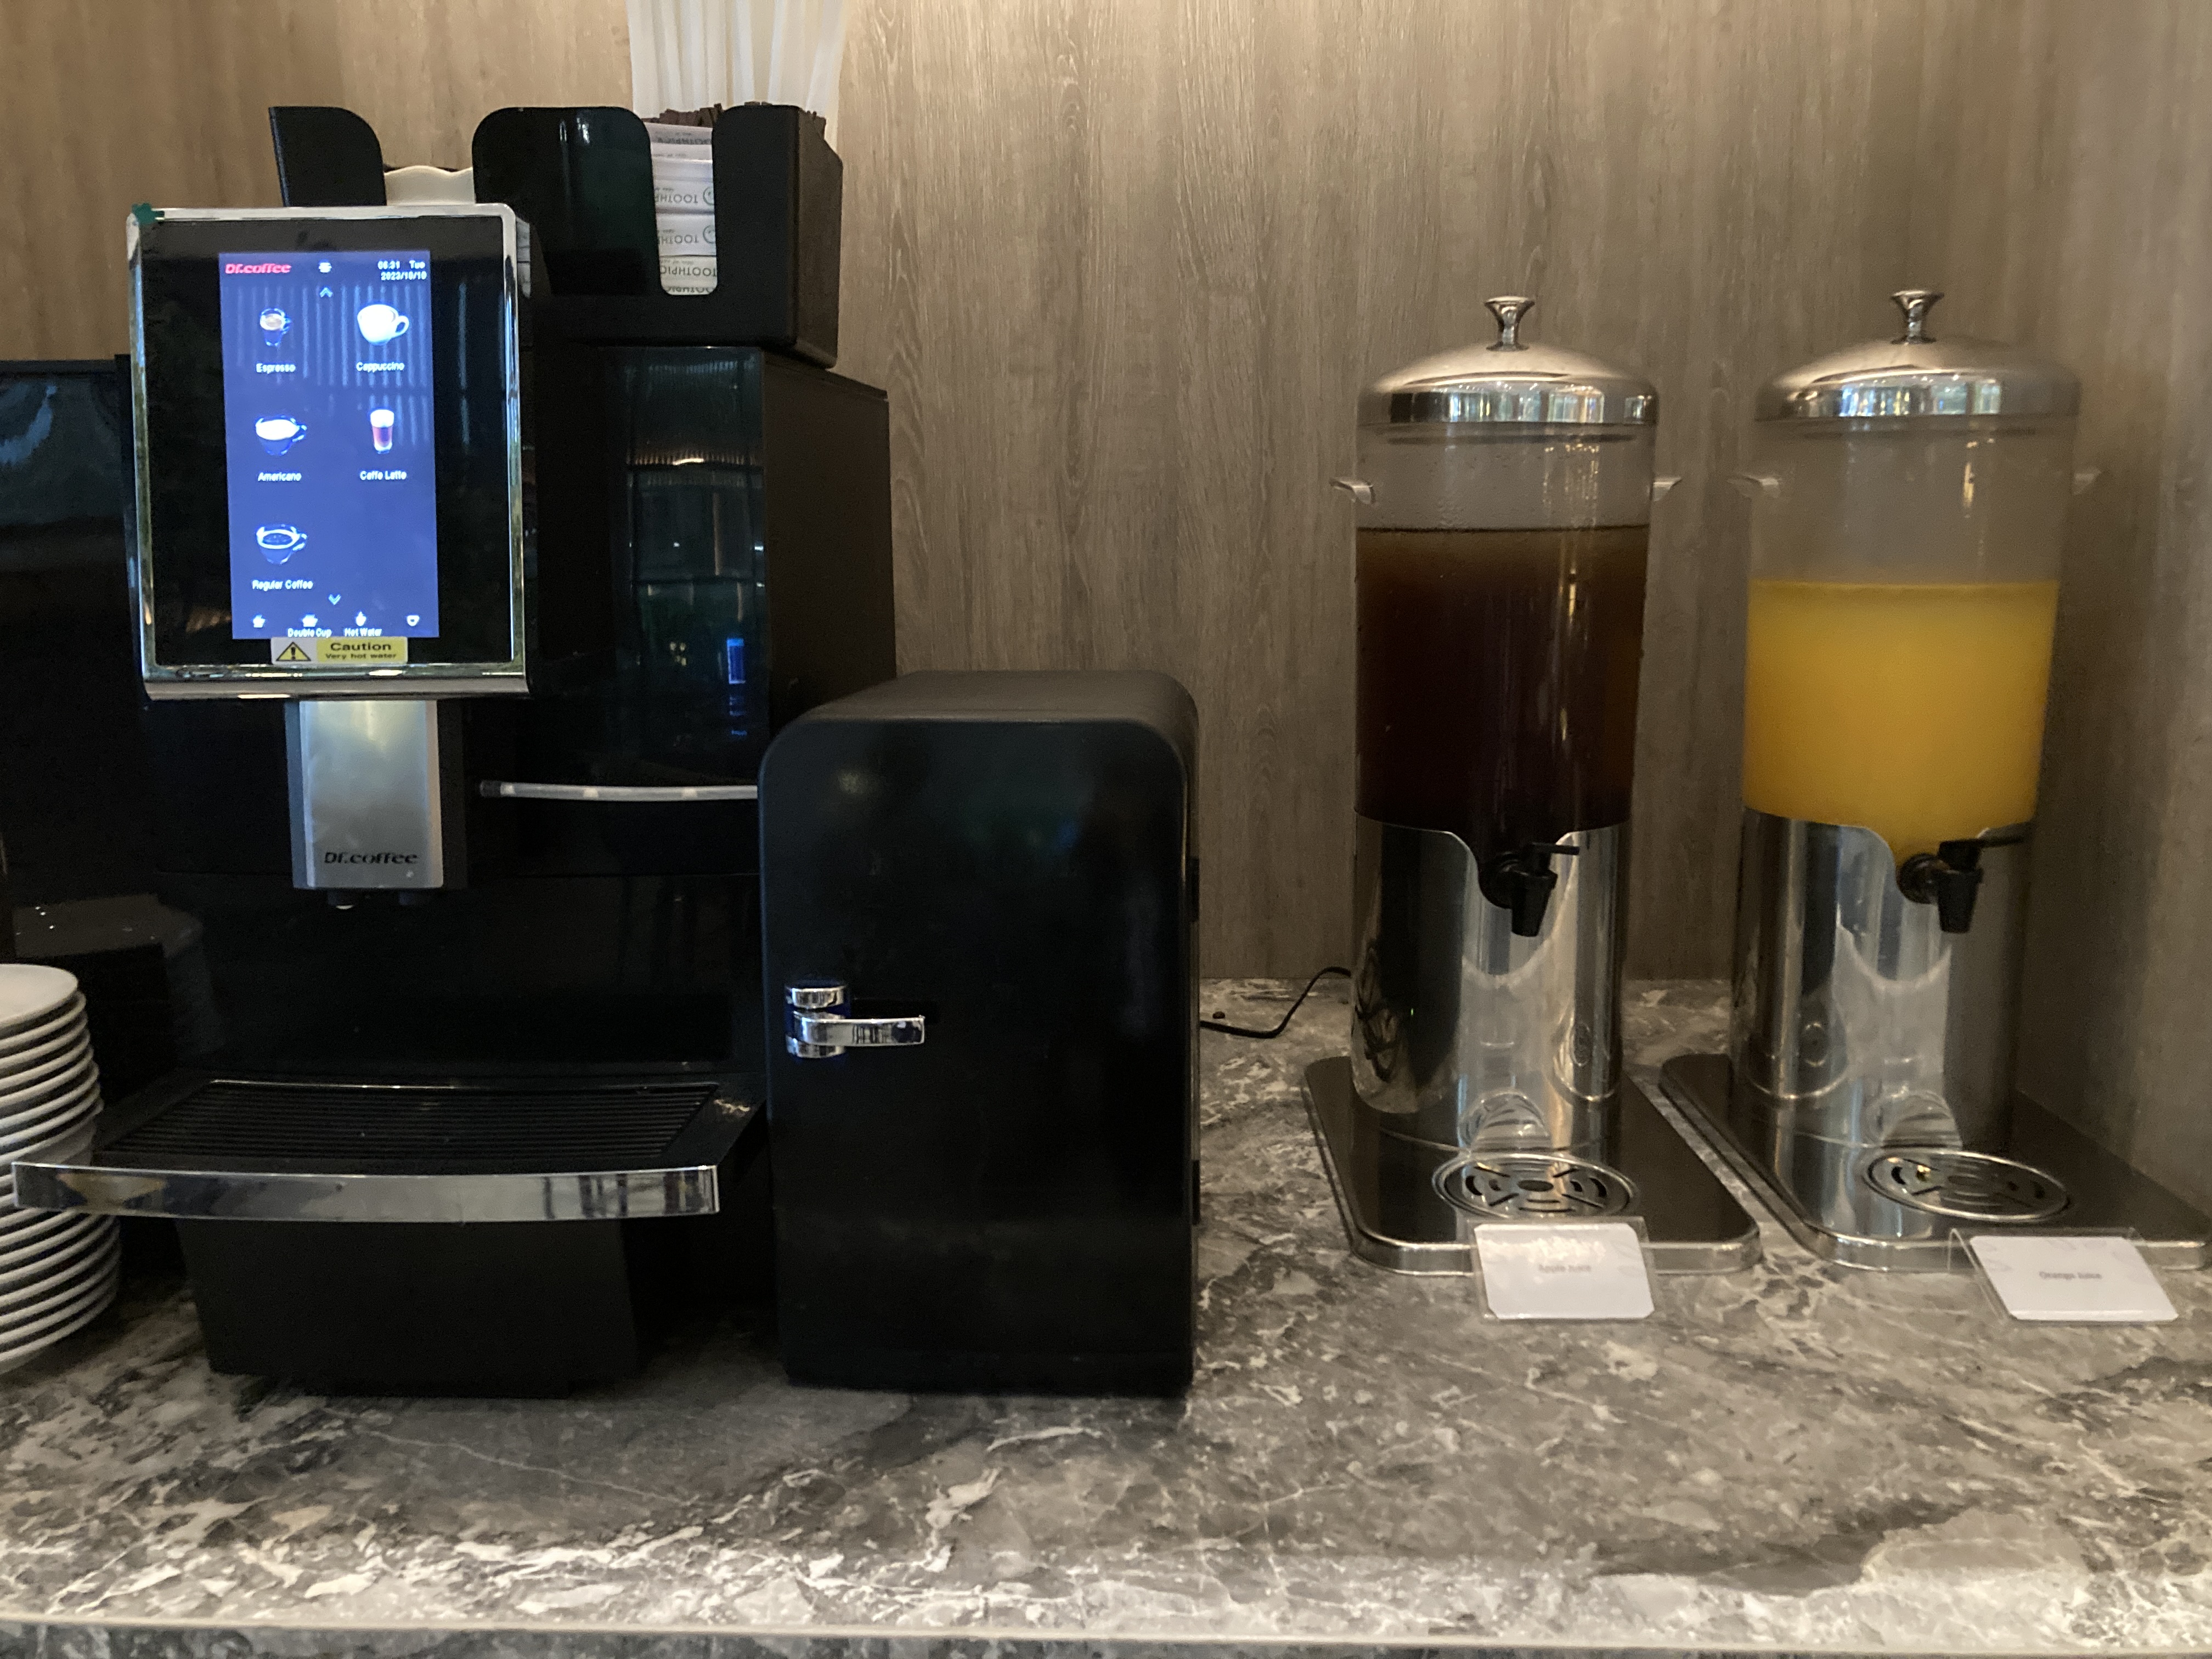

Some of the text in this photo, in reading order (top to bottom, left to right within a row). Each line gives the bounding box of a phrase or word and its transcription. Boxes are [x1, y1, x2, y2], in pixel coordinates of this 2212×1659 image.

[409, 260, 426, 269] Tue
[381, 270, 427, 281] 2023/10/10
[256, 363, 296, 374] Espresso
[356, 361, 404, 373] Cappuccino
[257, 471, 302, 482] Americano
[385, 471, 407, 481] Latte
[252, 579, 313, 591] Regular Coffee
[287, 628, 332, 638] Double Cup
[344, 628, 382, 637] Hot Water
[330, 642, 392, 651] Caution
[324, 851, 418, 865] Dr.coffee
